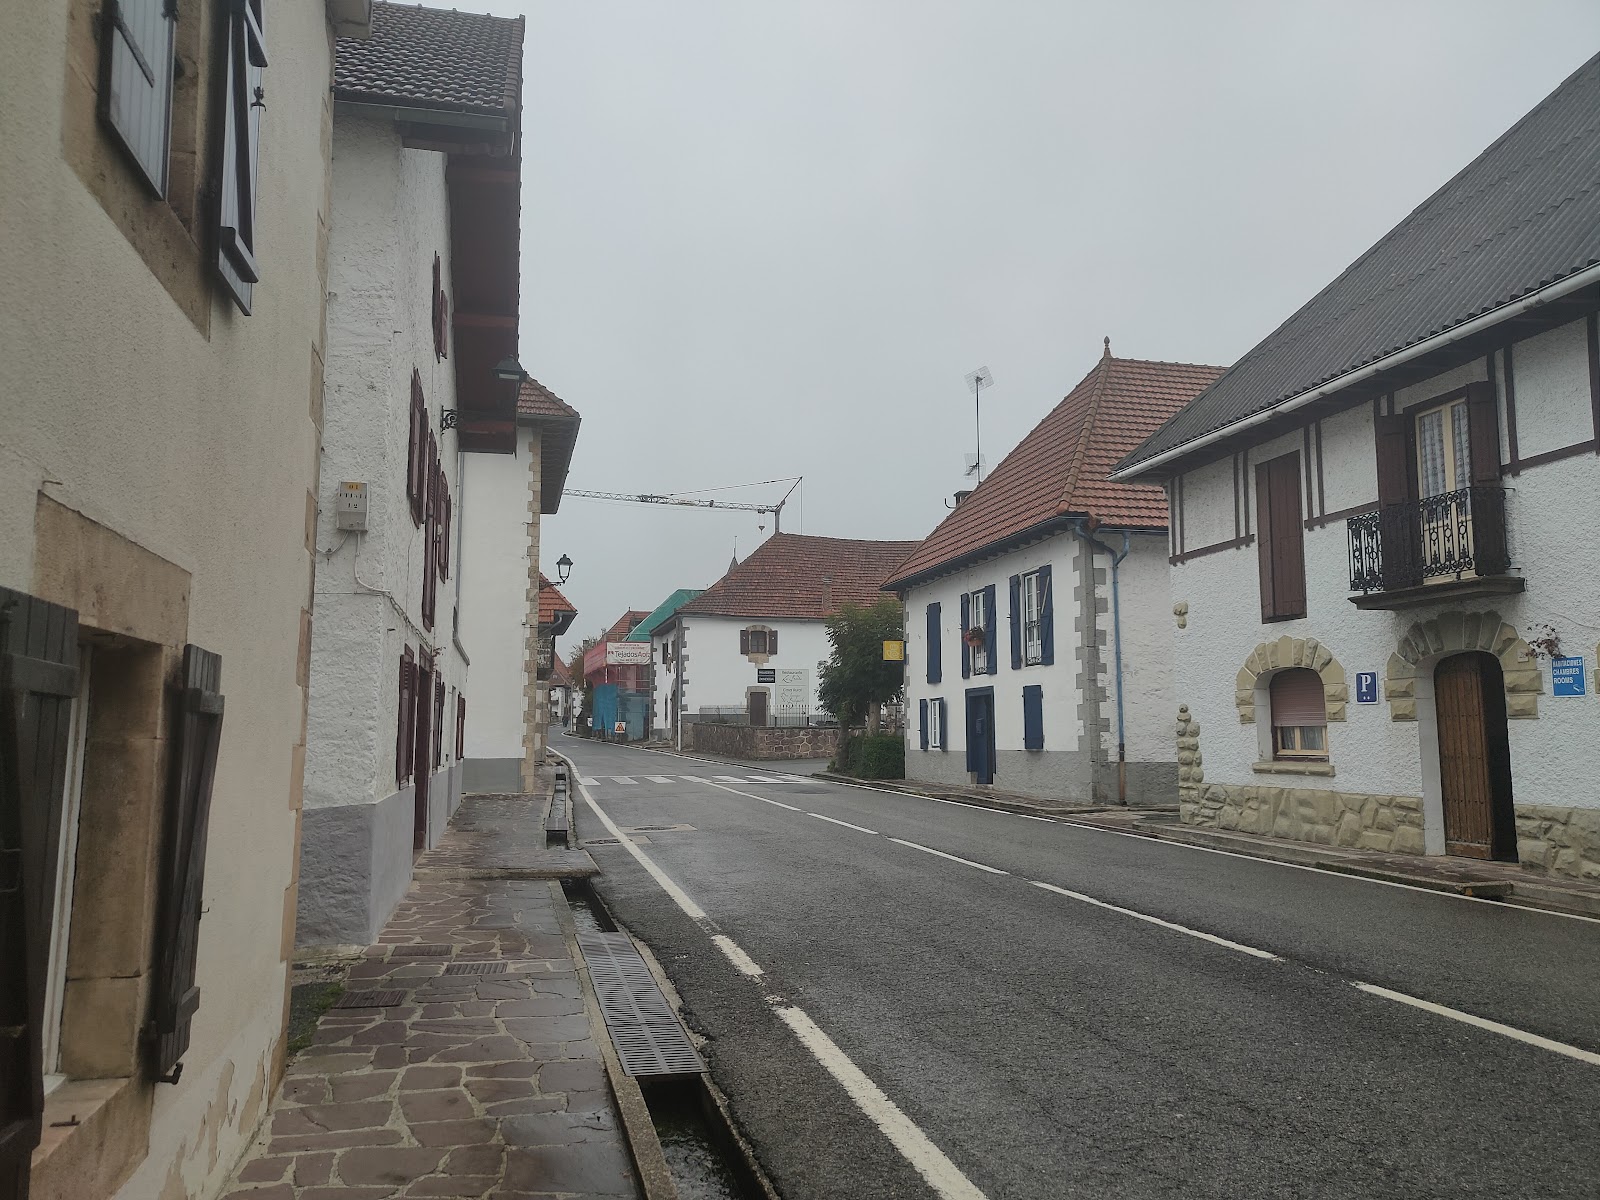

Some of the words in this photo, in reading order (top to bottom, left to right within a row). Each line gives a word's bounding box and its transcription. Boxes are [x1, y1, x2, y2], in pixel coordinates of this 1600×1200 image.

[1553, 668, 1580, 676] CHAMBRES
[1361, 674, 1372, 693] P
[1553, 676, 1574, 684] ROOMS
